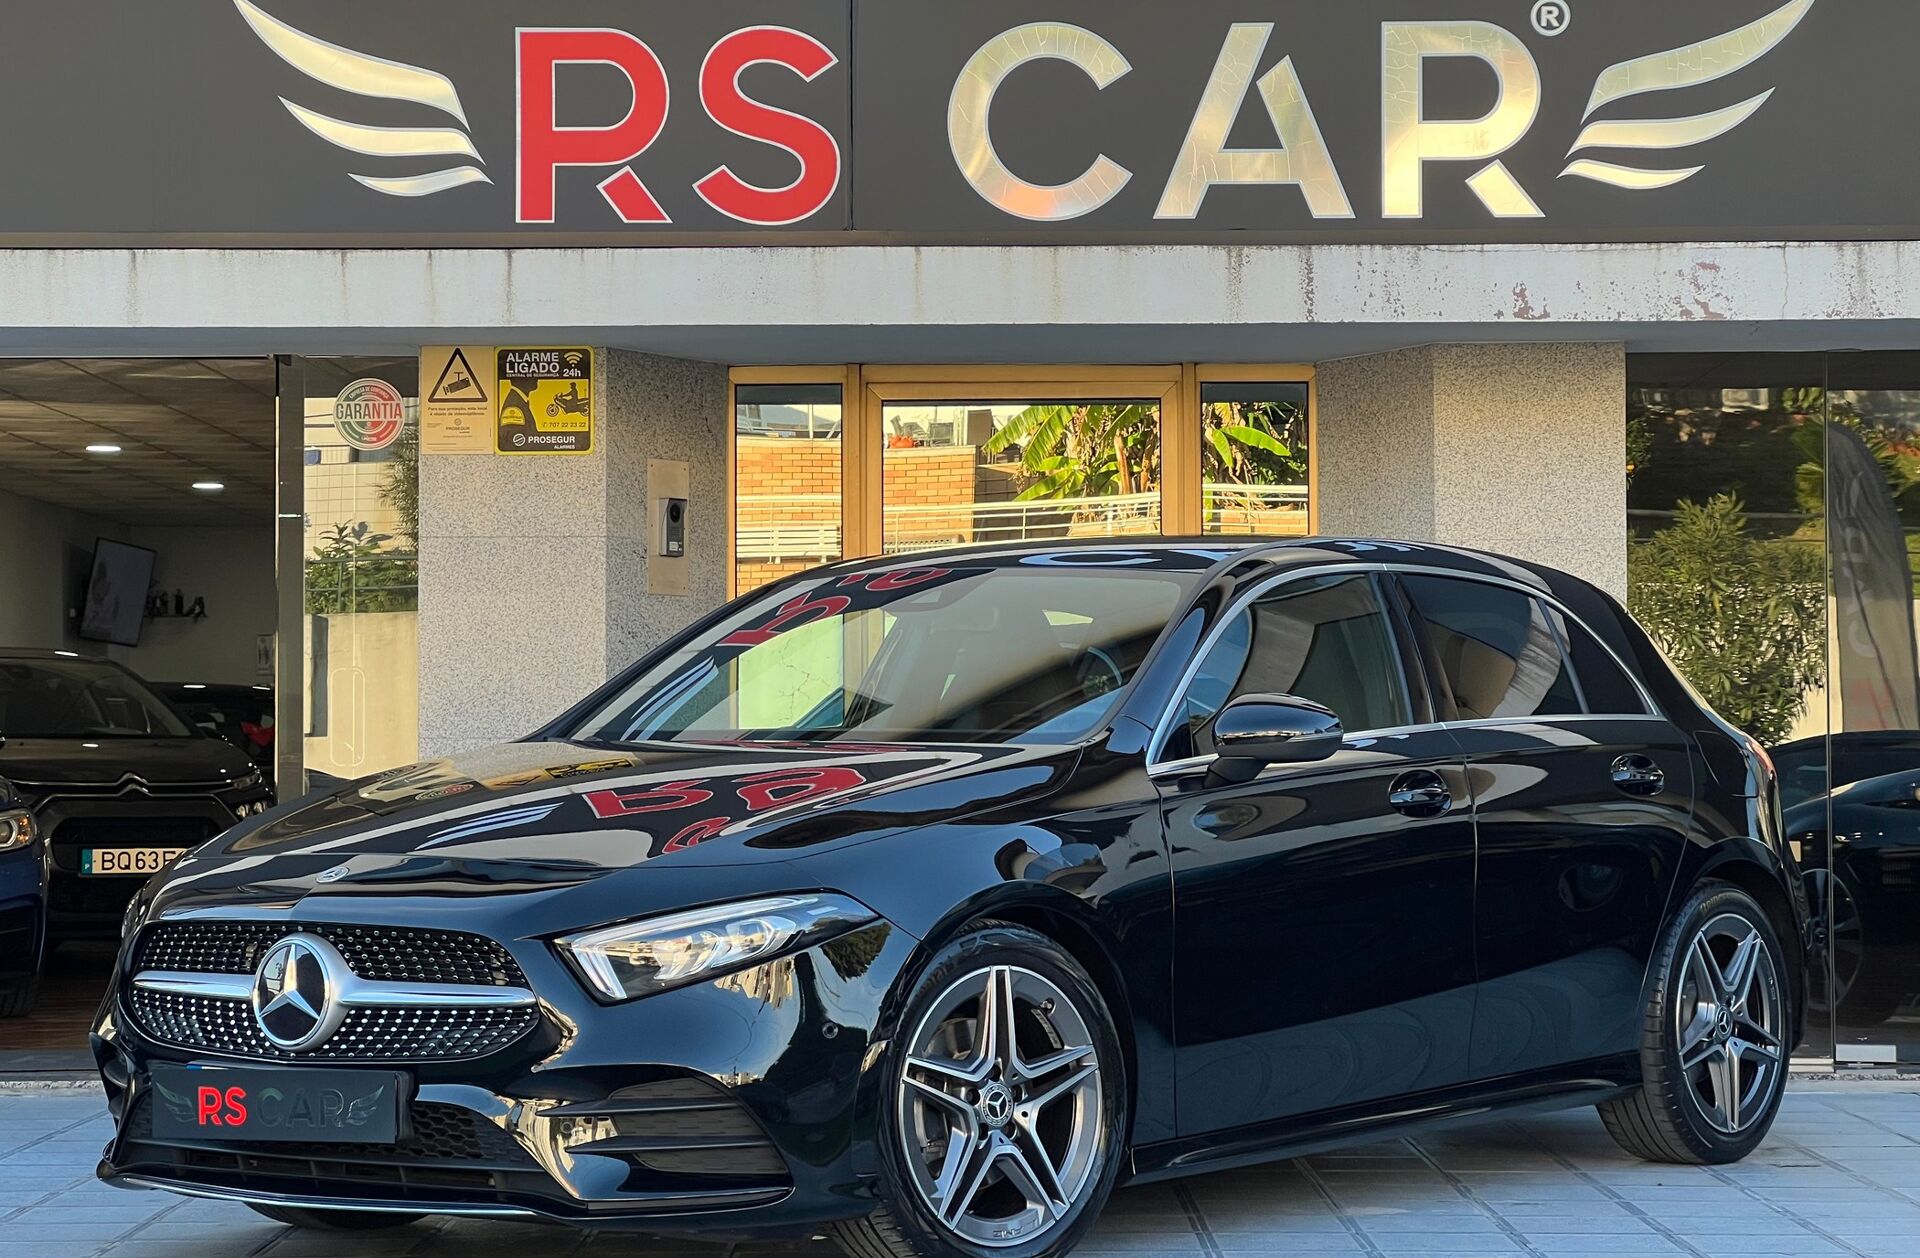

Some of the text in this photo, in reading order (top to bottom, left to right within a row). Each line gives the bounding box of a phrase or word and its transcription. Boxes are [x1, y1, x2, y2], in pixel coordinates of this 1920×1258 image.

[515, 25, 841, 225] RS
[948, 21, 1546, 221] CAR
[506, 352, 559, 362] ALARME
[506, 362, 560, 373] LIGADO
[563, 368, 581, 377] 24h
[336, 402, 402, 420] GARANTIA
[528, 436, 576, 444] PROSEGUR
[197, 1086, 345, 1128] RS CAR
